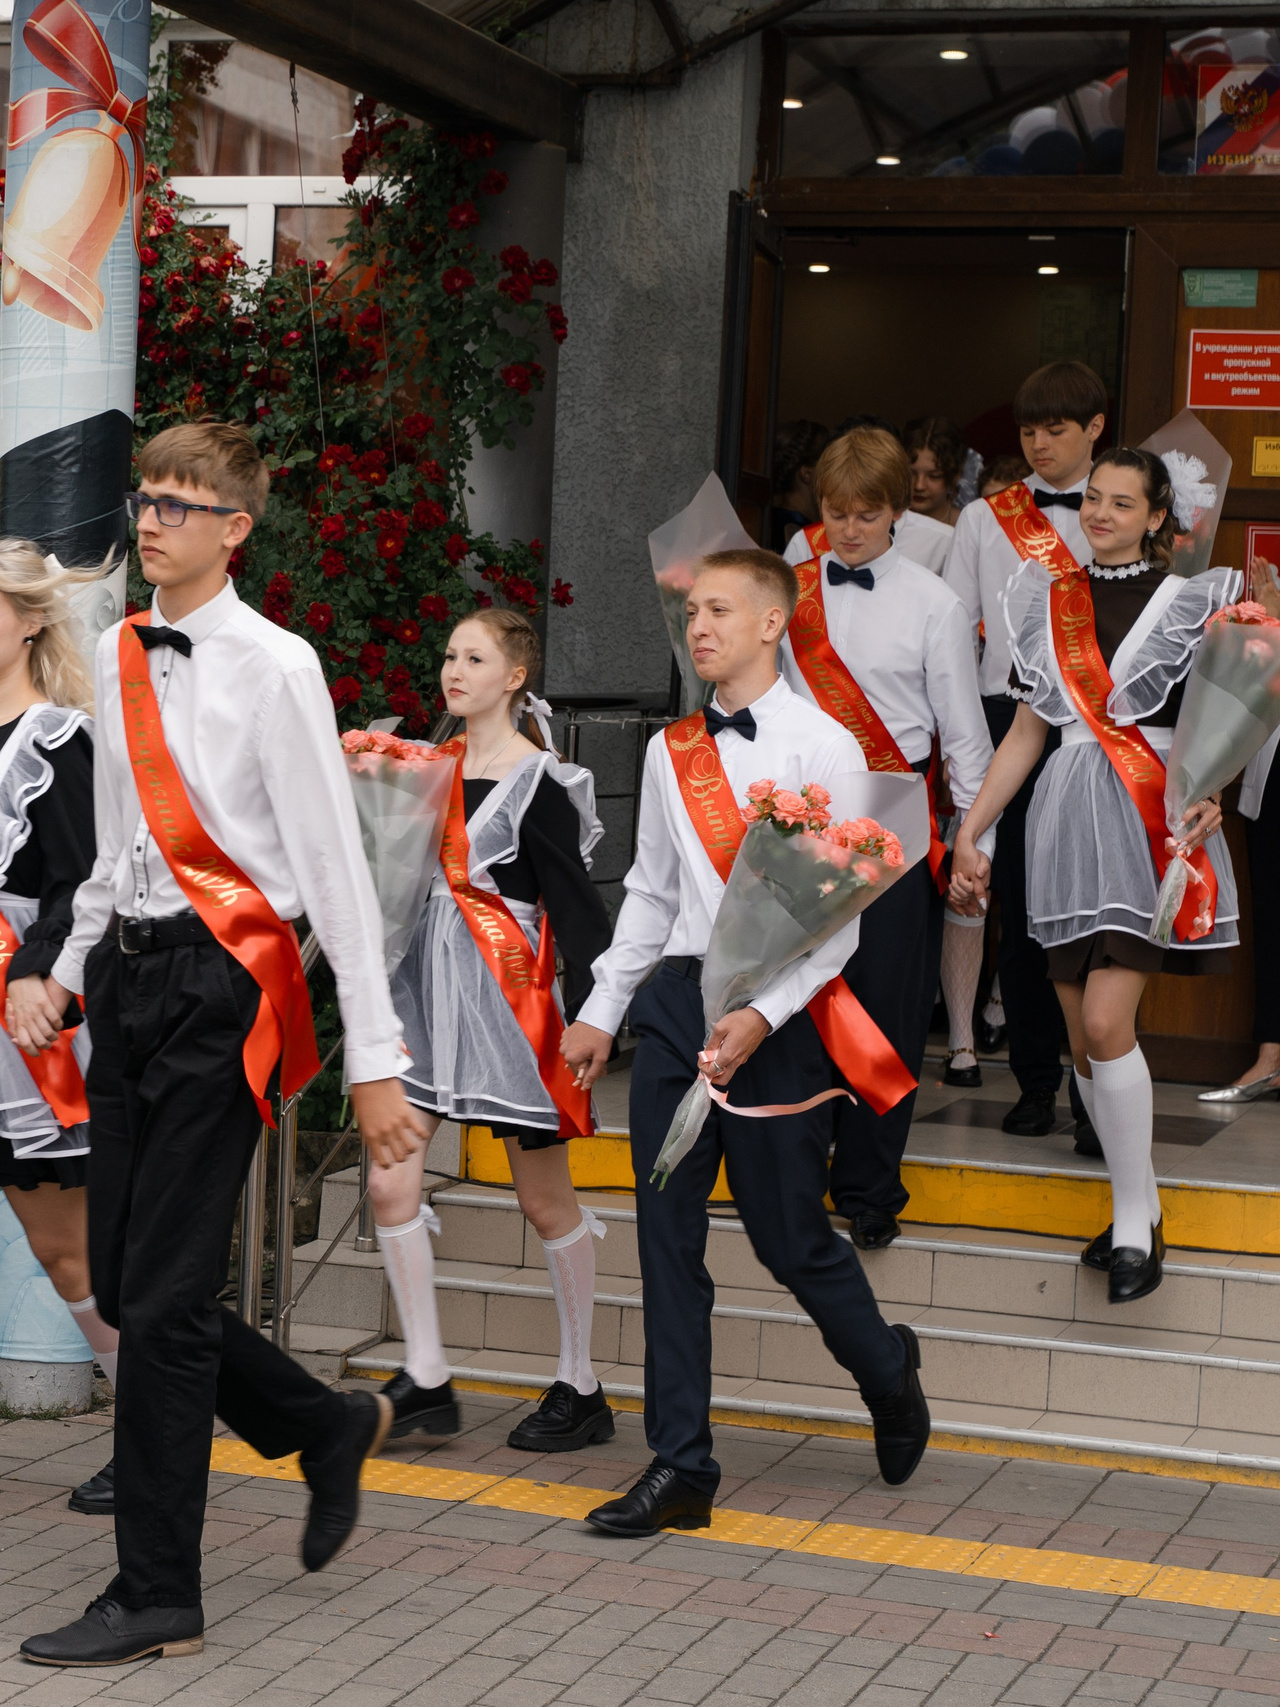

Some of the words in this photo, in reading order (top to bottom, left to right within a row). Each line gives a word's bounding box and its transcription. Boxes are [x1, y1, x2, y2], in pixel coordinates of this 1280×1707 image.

[1195, 342, 1201, 352] В
[1202, 344, 1253, 354] учреждении
[1223, 357, 1271, 369] пропускной
[1231, 386, 1261, 397] режим
[795, 597, 875, 751] Выпускник
[1115, 743, 1162, 783] 2026
[685, 743, 738, 866] Выпус
[181, 856, 252, 909] 2026
[441, 805, 507, 944] ыпускница
[492, 943, 539, 989] 2026
